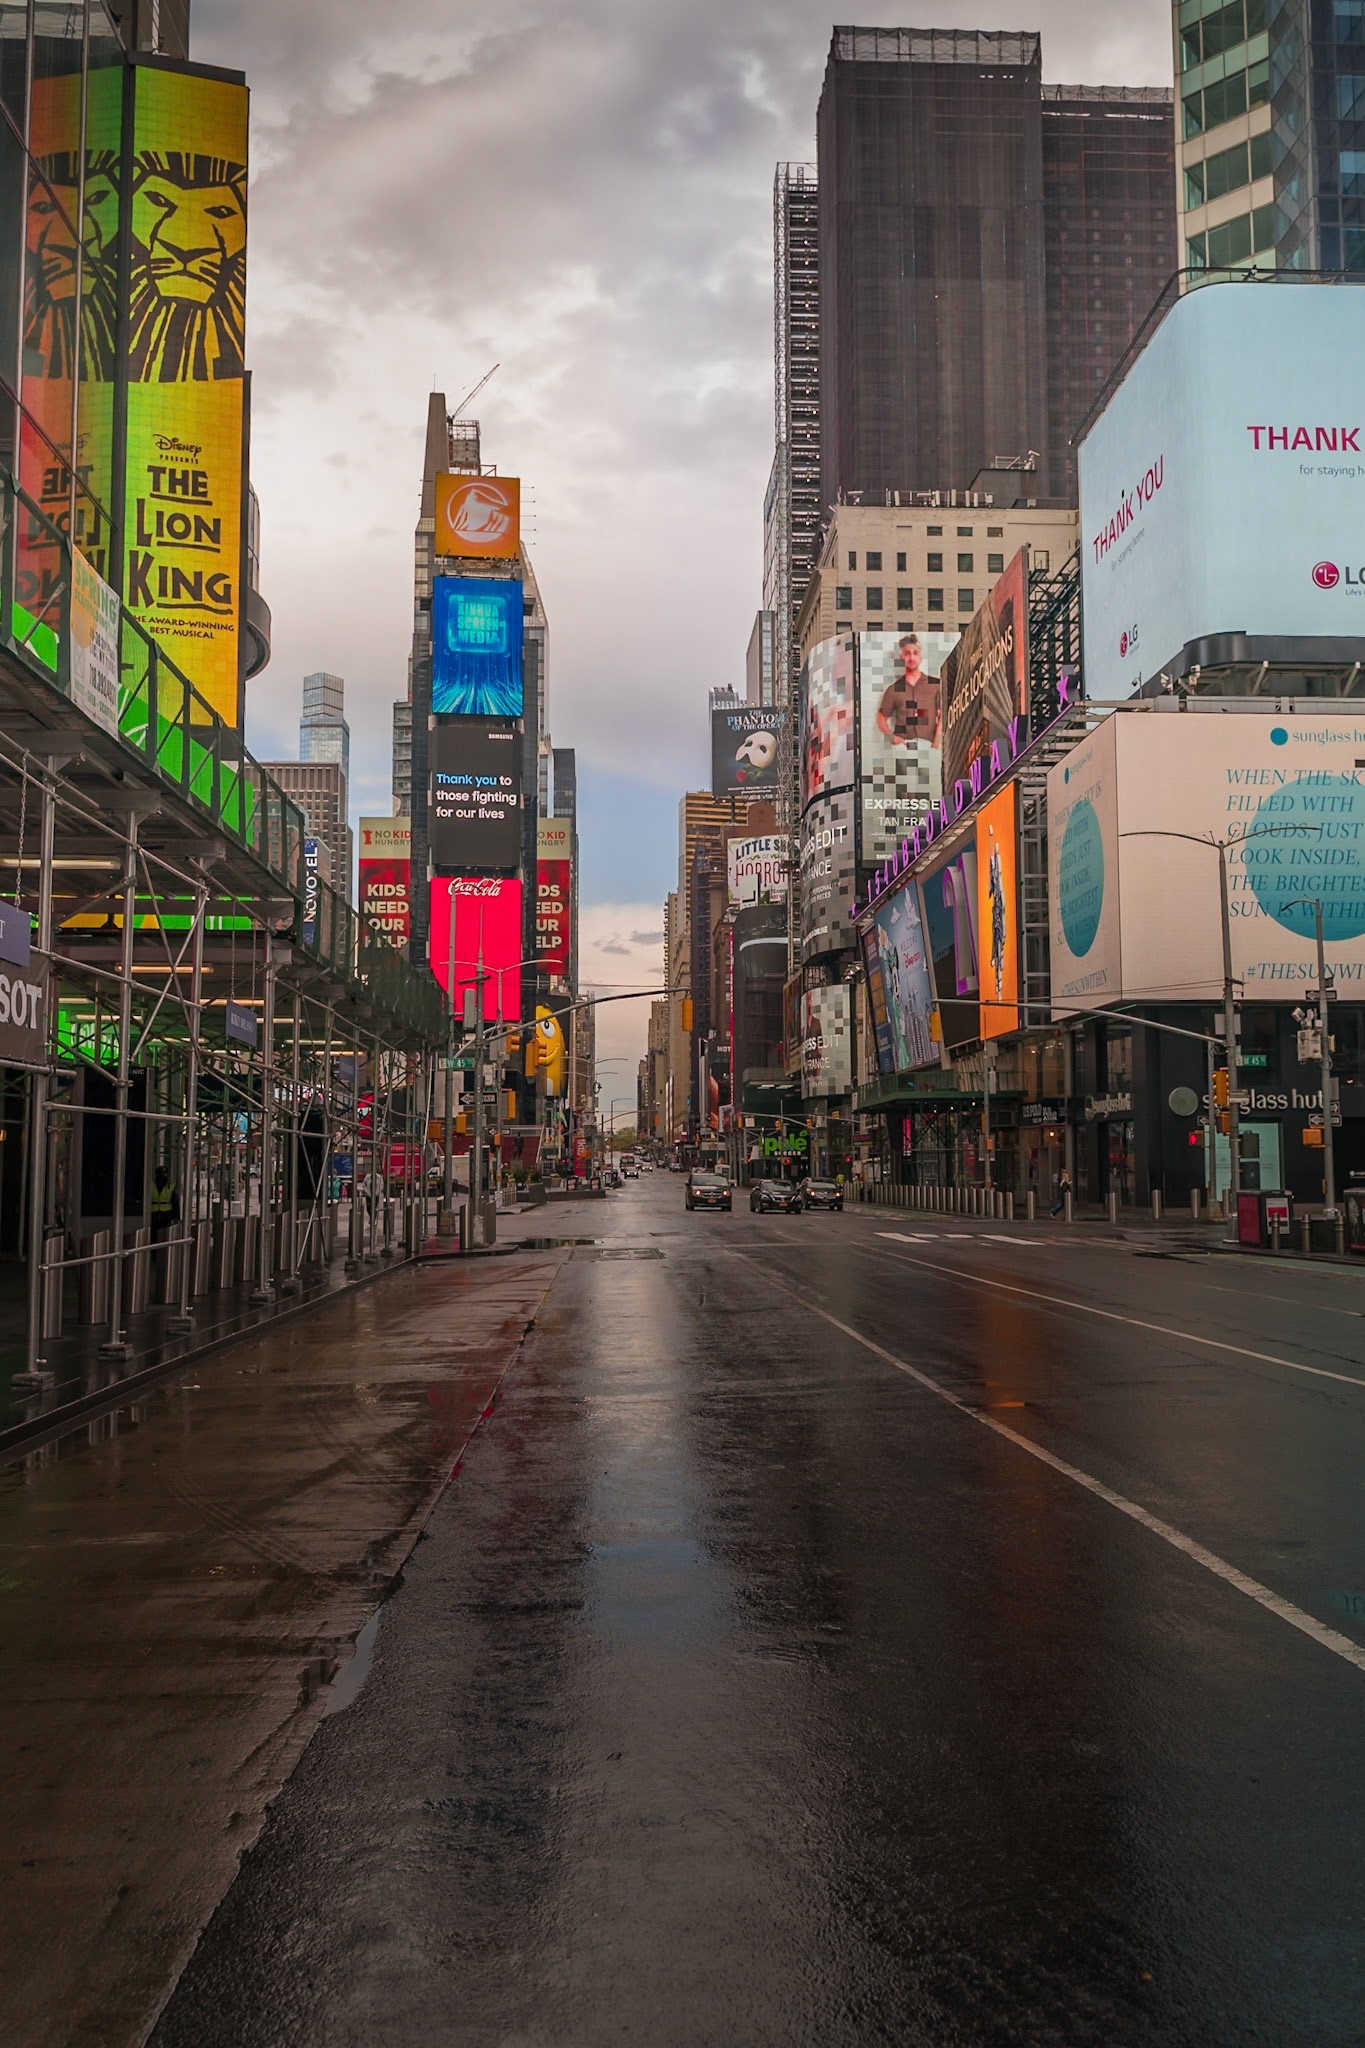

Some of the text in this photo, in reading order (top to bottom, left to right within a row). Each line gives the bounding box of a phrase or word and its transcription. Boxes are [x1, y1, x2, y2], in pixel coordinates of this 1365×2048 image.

[1247, 426, 1361, 452] THANK
[160, 454, 199, 464] PRESENTS
[1300, 465, 1315, 475] for
[1317, 465, 1355, 478] staying
[147, 464, 209, 498] THE
[1093, 454, 1164, 565] THANK YOU
[136, 498, 221, 545] LION
[128, 550, 232, 608] KING
[133, 614, 235, 632] HE AWARD-WINNING
[457, 616, 499, 631] SCREEN
[149, 626, 215, 640] BEST MUSICAL
[458, 630, 499, 644] MEDIA
[947, 682, 970, 730] OFFICE
[969, 624, 1013, 702] LOCATIONS
[727, 712, 787, 726] PHANTOM
[1292, 729, 1351, 746] sunglass
[436, 773, 513, 788] Thank you to
[1226, 768, 1287, 785] WHEN
[1294, 769, 1332, 786] THE
[435, 790, 517, 806] those fighting
[902, 715, 1019, 868] BROADWAY
[864, 798, 929, 811] EXPRESS
[1226, 795, 1355, 812] FILLED WITH
[435, 806, 505, 820] for our lives
[878, 817, 926, 827] TAN FRA
[375, 830, 411, 839] NO KID
[546, 831, 566, 839] KID
[815, 825, 847, 850] EDIT
[1227, 821, 1364, 843] CLOUDS, JUST
[736, 838, 771, 861] LITTLE
[1228, 849, 1360, 868] LOOK INSIDE,
[368, 884, 406, 897] KIDS
[1230, 874, 1268, 891] THE
[364, 901, 409, 914] NEED
[1230, 901, 1365, 919] SUN IS WITHI
[368, 918, 405, 931] OUR
[1247, 962, 1365, 980] #THESUNWI
[817, 1034, 841, 1049] EDIT
[457, 1060, 465, 1068] 45
[1252, 1057, 1260, 1065] 45
[1292, 1087, 1324, 1109] hut
[764, 1130, 808, 1156] plé
